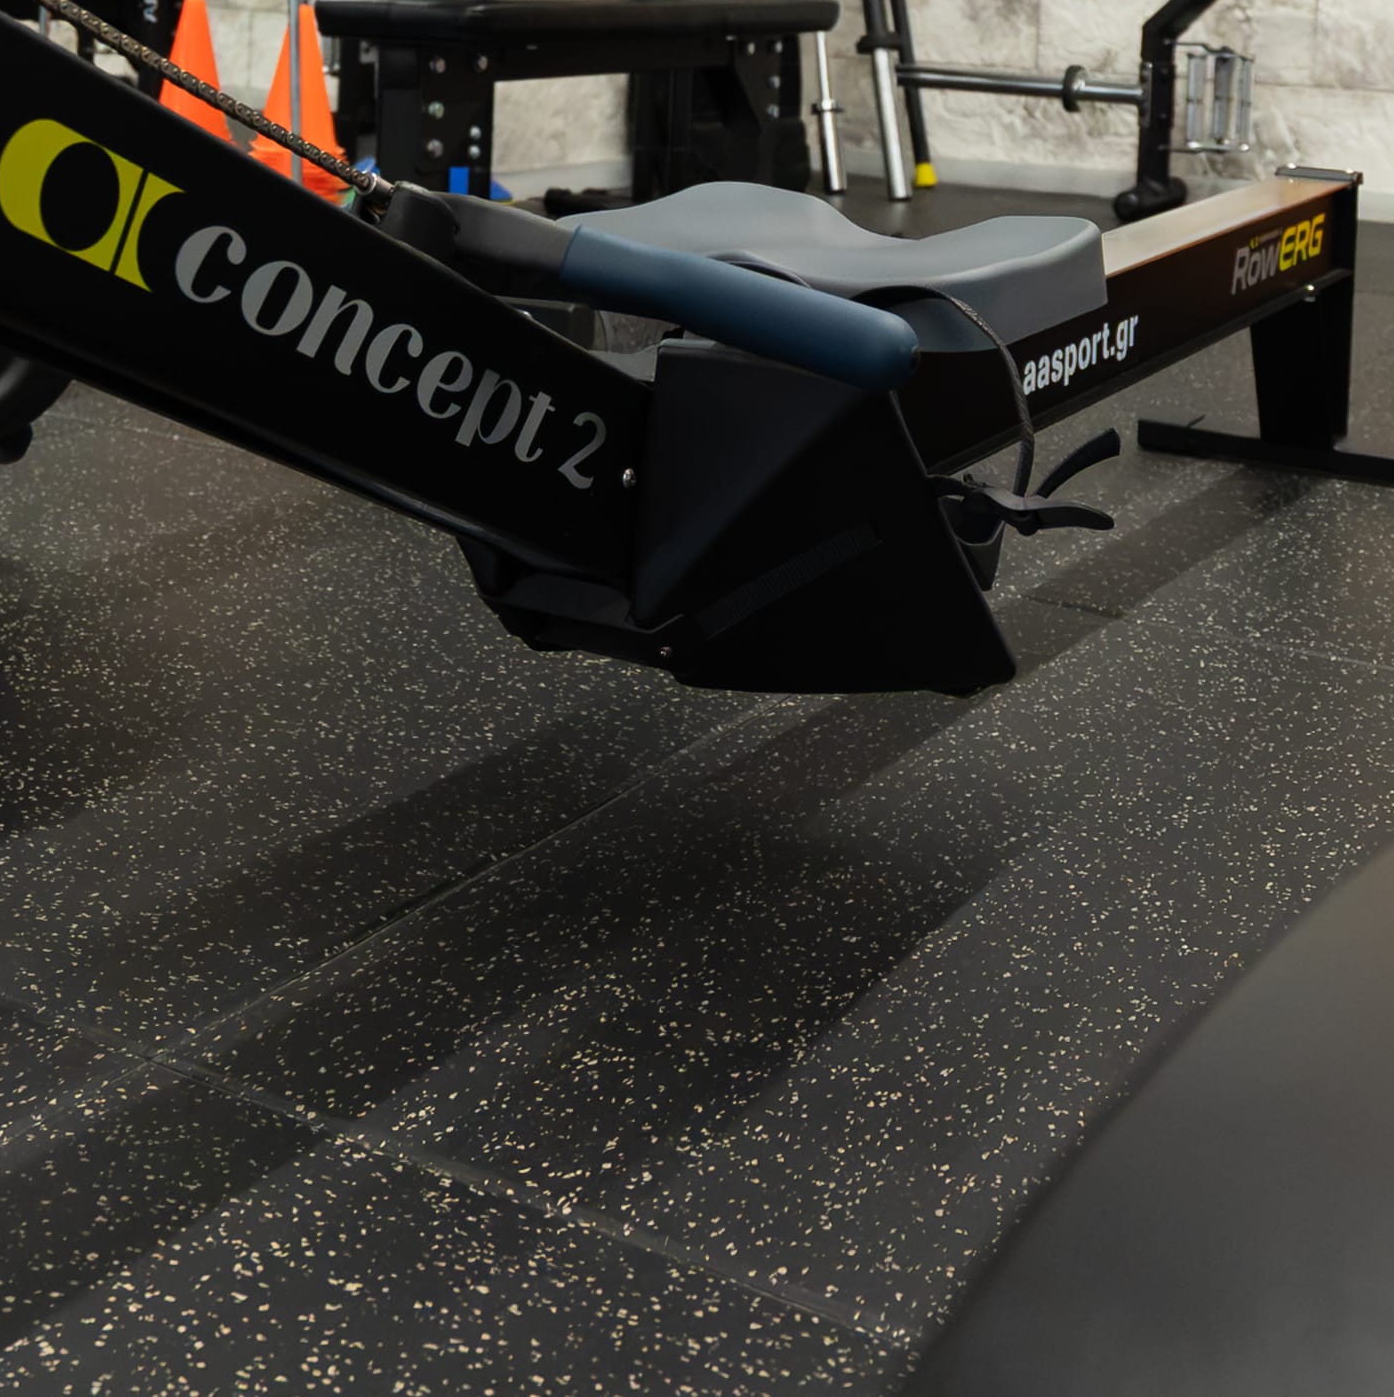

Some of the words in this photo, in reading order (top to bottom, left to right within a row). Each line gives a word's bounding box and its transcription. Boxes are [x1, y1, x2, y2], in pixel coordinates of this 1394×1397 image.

[175, 226, 555, 462] concept
[558, 412, 605, 490] 2
[1023, 314, 1138, 396] aasport.gr
